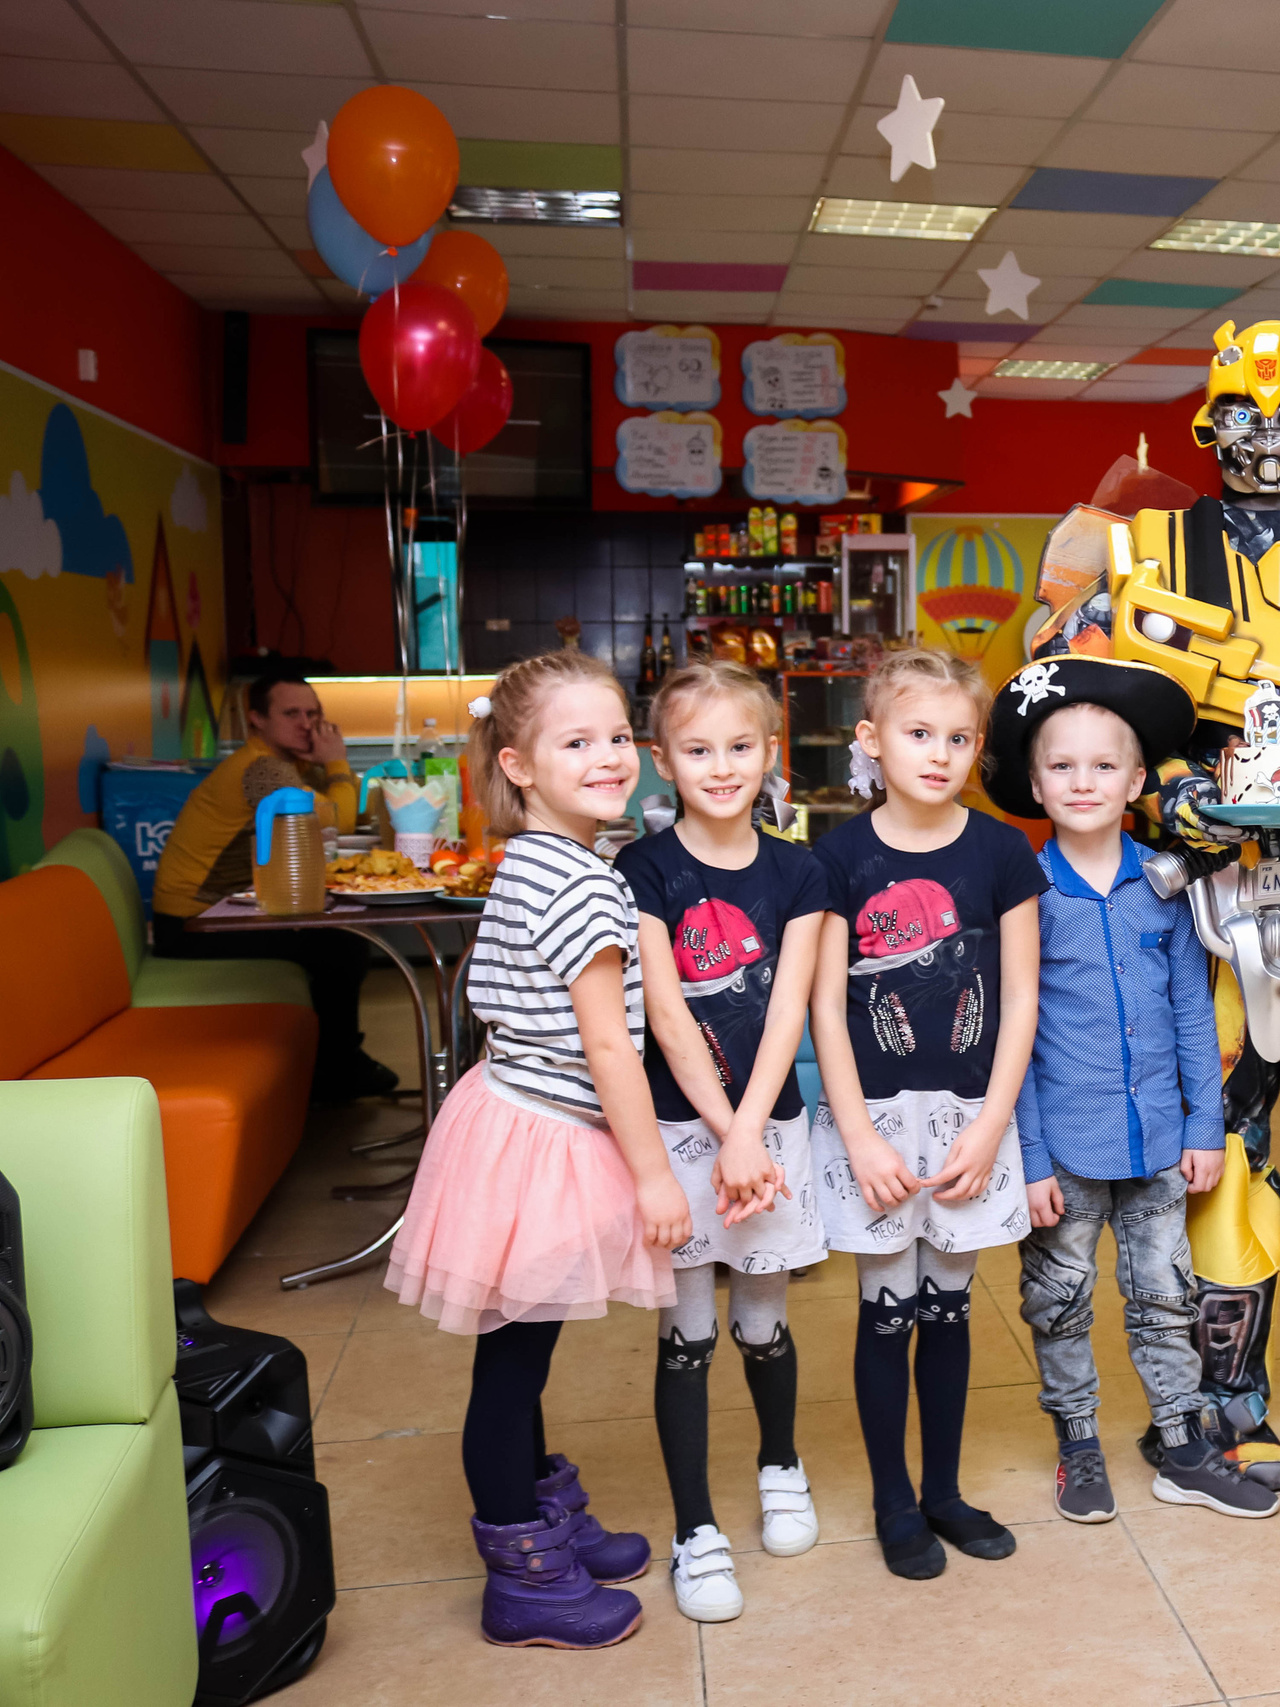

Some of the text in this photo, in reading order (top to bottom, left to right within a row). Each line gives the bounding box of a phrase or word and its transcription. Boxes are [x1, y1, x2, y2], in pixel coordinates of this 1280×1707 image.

[867, 909, 898, 934] YO!
[682, 925, 708, 951] YO!
[815, 1107, 835, 1129] EOW
[677, 1136, 713, 1163] MEOW
[870, 1216, 905, 1242] MEOW
[677, 1233, 711, 1264] MEOW
